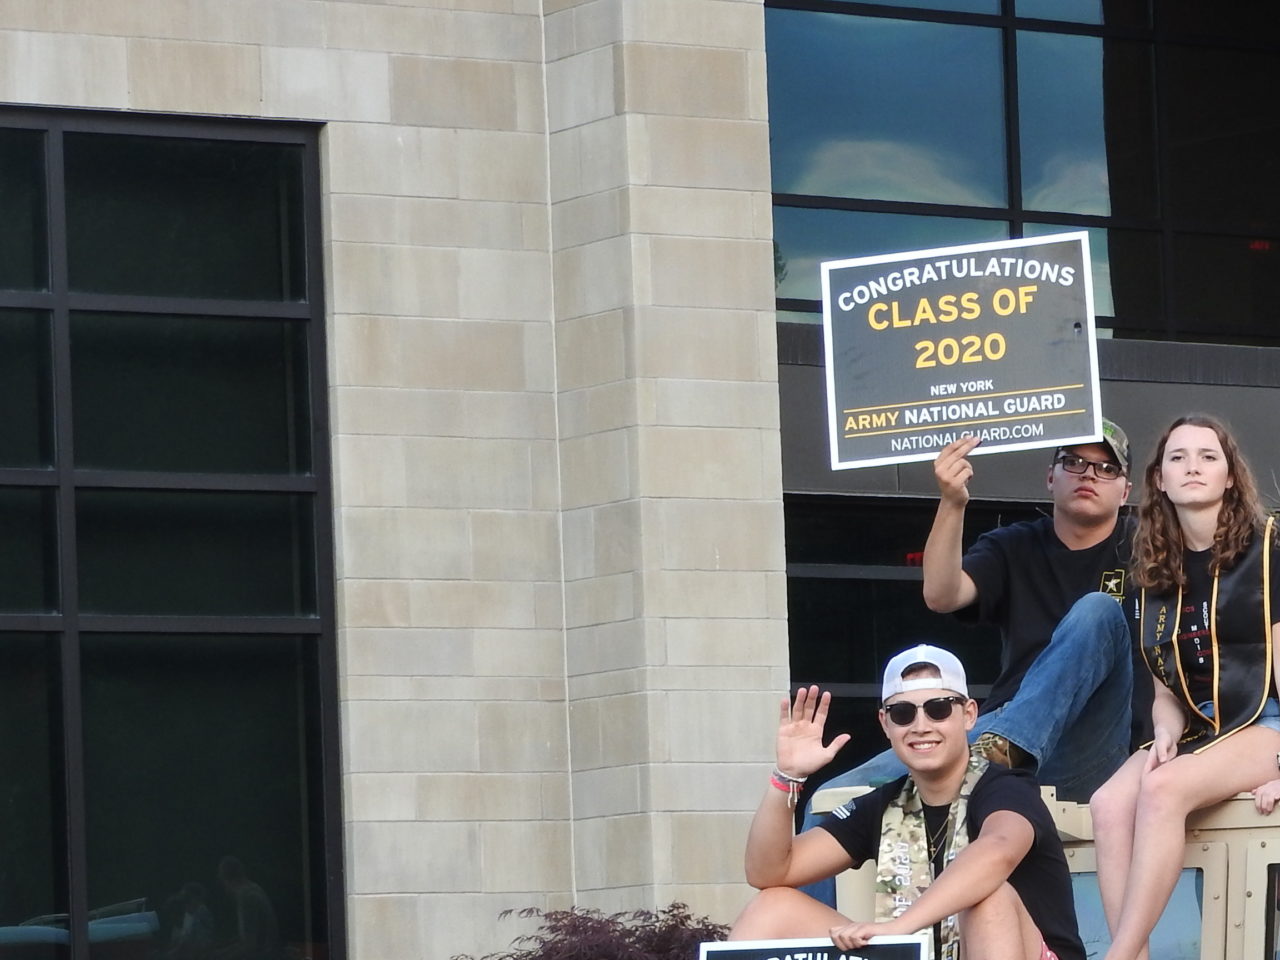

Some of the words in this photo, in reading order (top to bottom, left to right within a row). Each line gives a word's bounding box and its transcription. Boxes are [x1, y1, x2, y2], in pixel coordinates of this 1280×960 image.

[838, 257, 1075, 311] CONGRATULATIONS
[868, 292, 981, 331] CLASS
[992, 285, 1038, 316] OF
[914, 333, 1006, 369] 2020
[930, 384, 957, 396] NEW
[960, 379, 993, 392] YORK
[844, 411, 898, 431] ARMY
[904, 398, 999, 425] NATIONAL
[1004, 393, 1066, 414] GUARD
[1155, 605, 1168, 641] ARMY
